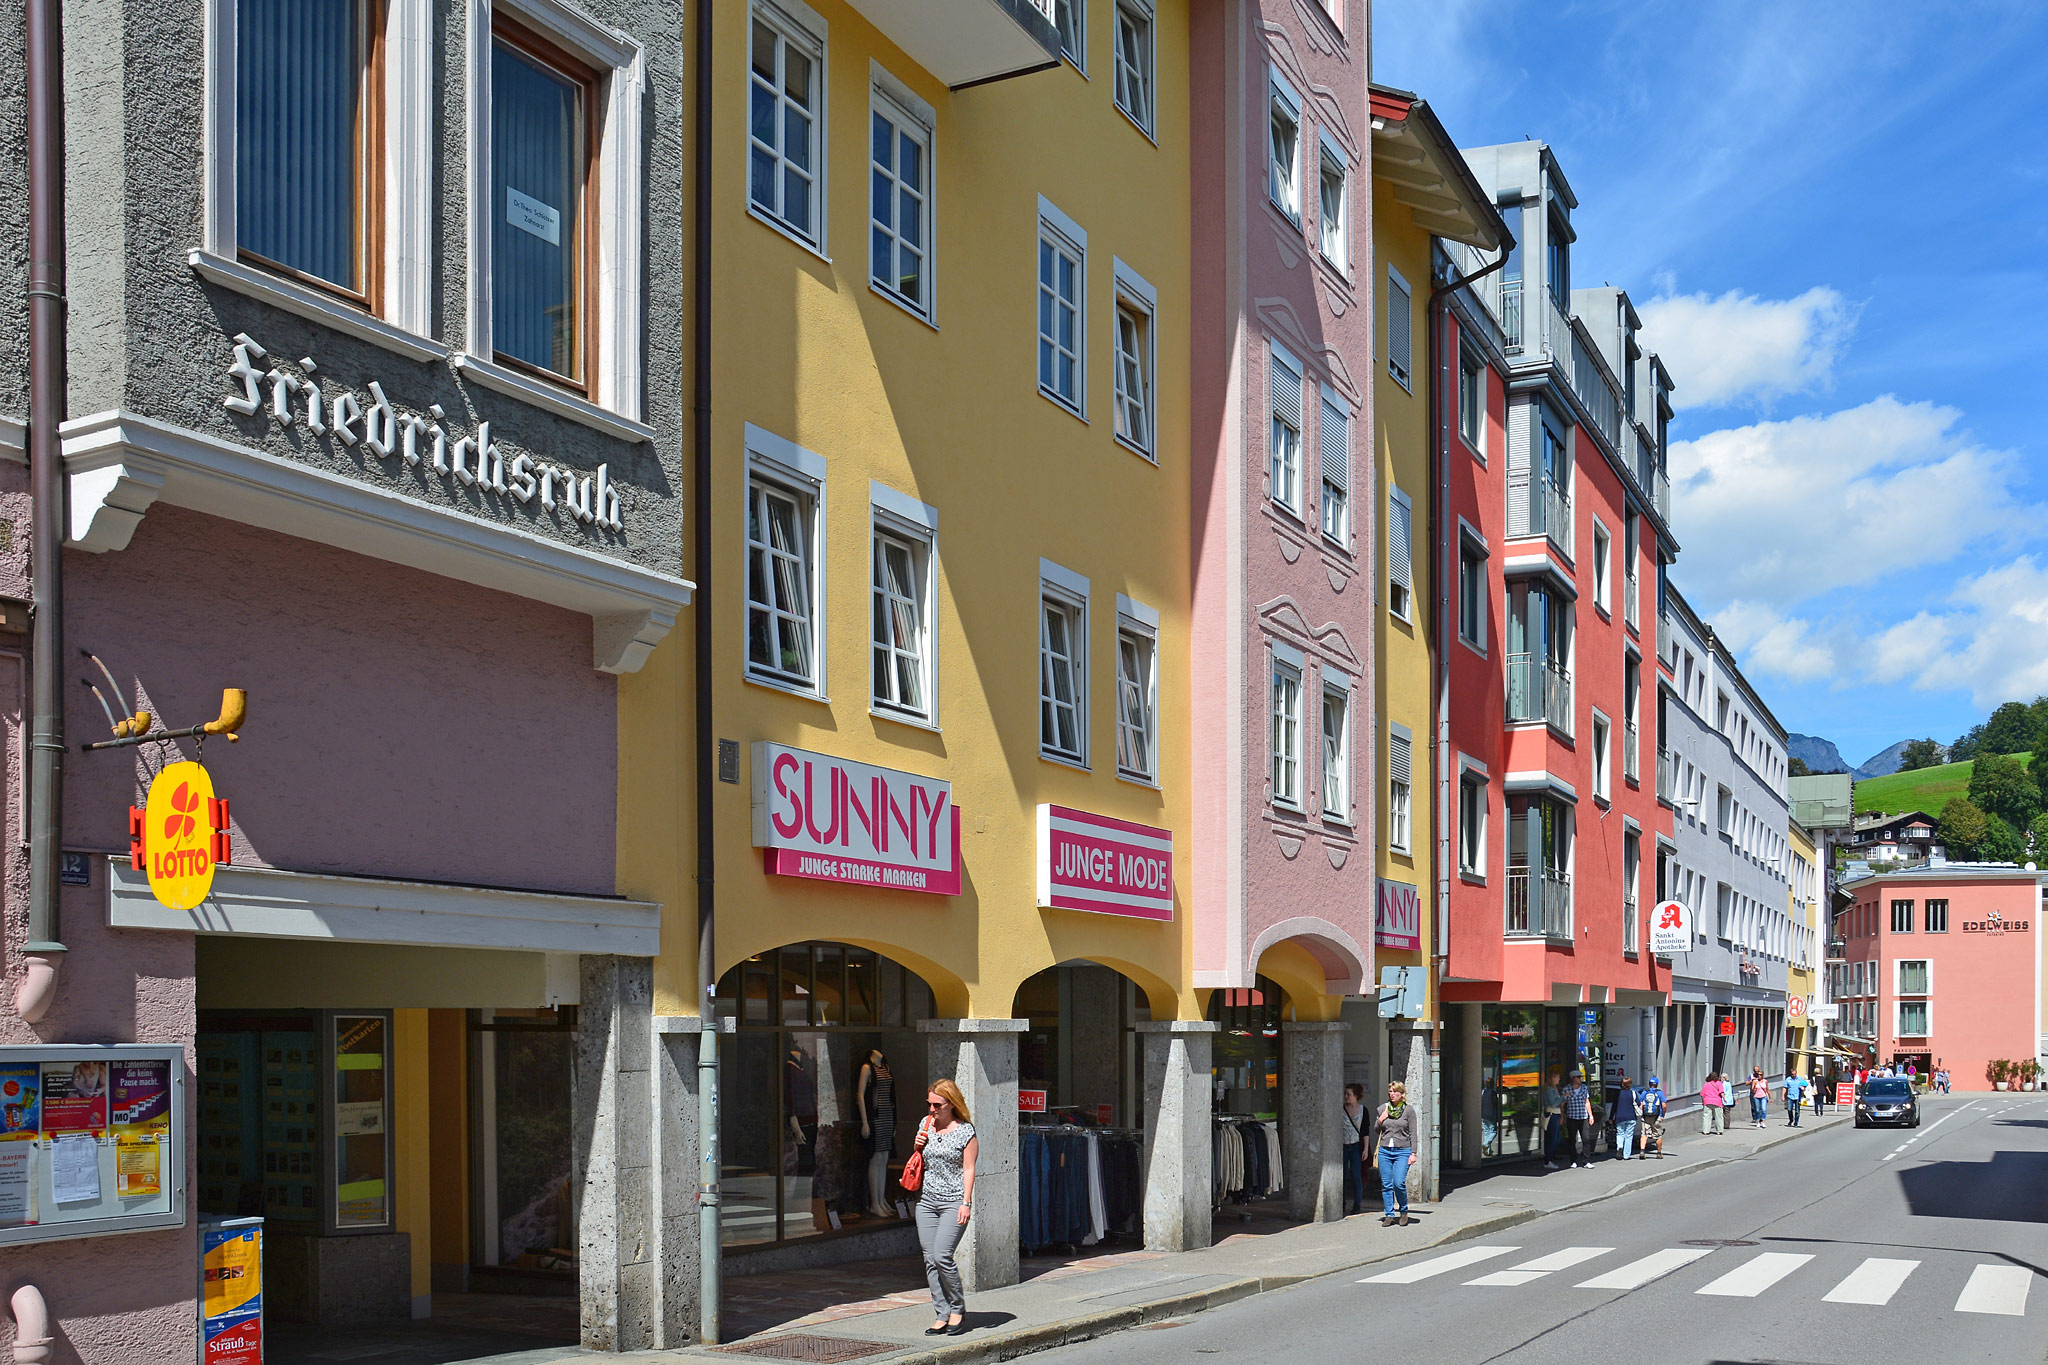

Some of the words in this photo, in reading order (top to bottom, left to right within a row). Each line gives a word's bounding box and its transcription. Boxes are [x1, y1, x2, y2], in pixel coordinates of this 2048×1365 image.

[223, 332, 623, 533] Friedrichsruh
[771, 752, 948, 861] SUNNY
[61, 854, 81, 873] 12
[154, 847, 208, 880] LOTTO
[798, 856, 838, 878] JUNGE
[840, 862, 881, 883] STARKE
[883, 868, 927, 889] MARKEN
[1055, 841, 1114, 884] JUNGE
[1119, 852, 1167, 892] MODE
[1375, 882, 1417, 931] UNNY
[1962, 920, 2029, 931] EDELWEISS
[337, 1019, 383, 1054] Postkarten
[112, 1061, 122, 1069] Die
[1605, 1051, 1626, 1061] lter
[120, 1078, 138, 1087] Pause
[139, 1077, 159, 1086] macht.
[126, 1069, 136, 1078] die
[137, 1069, 153, 1077] keine
[1018, 1095, 1043, 1106] SALE
[114, 1113, 129, 1122] MO
[209, 1336, 244, 1353] Strauß
